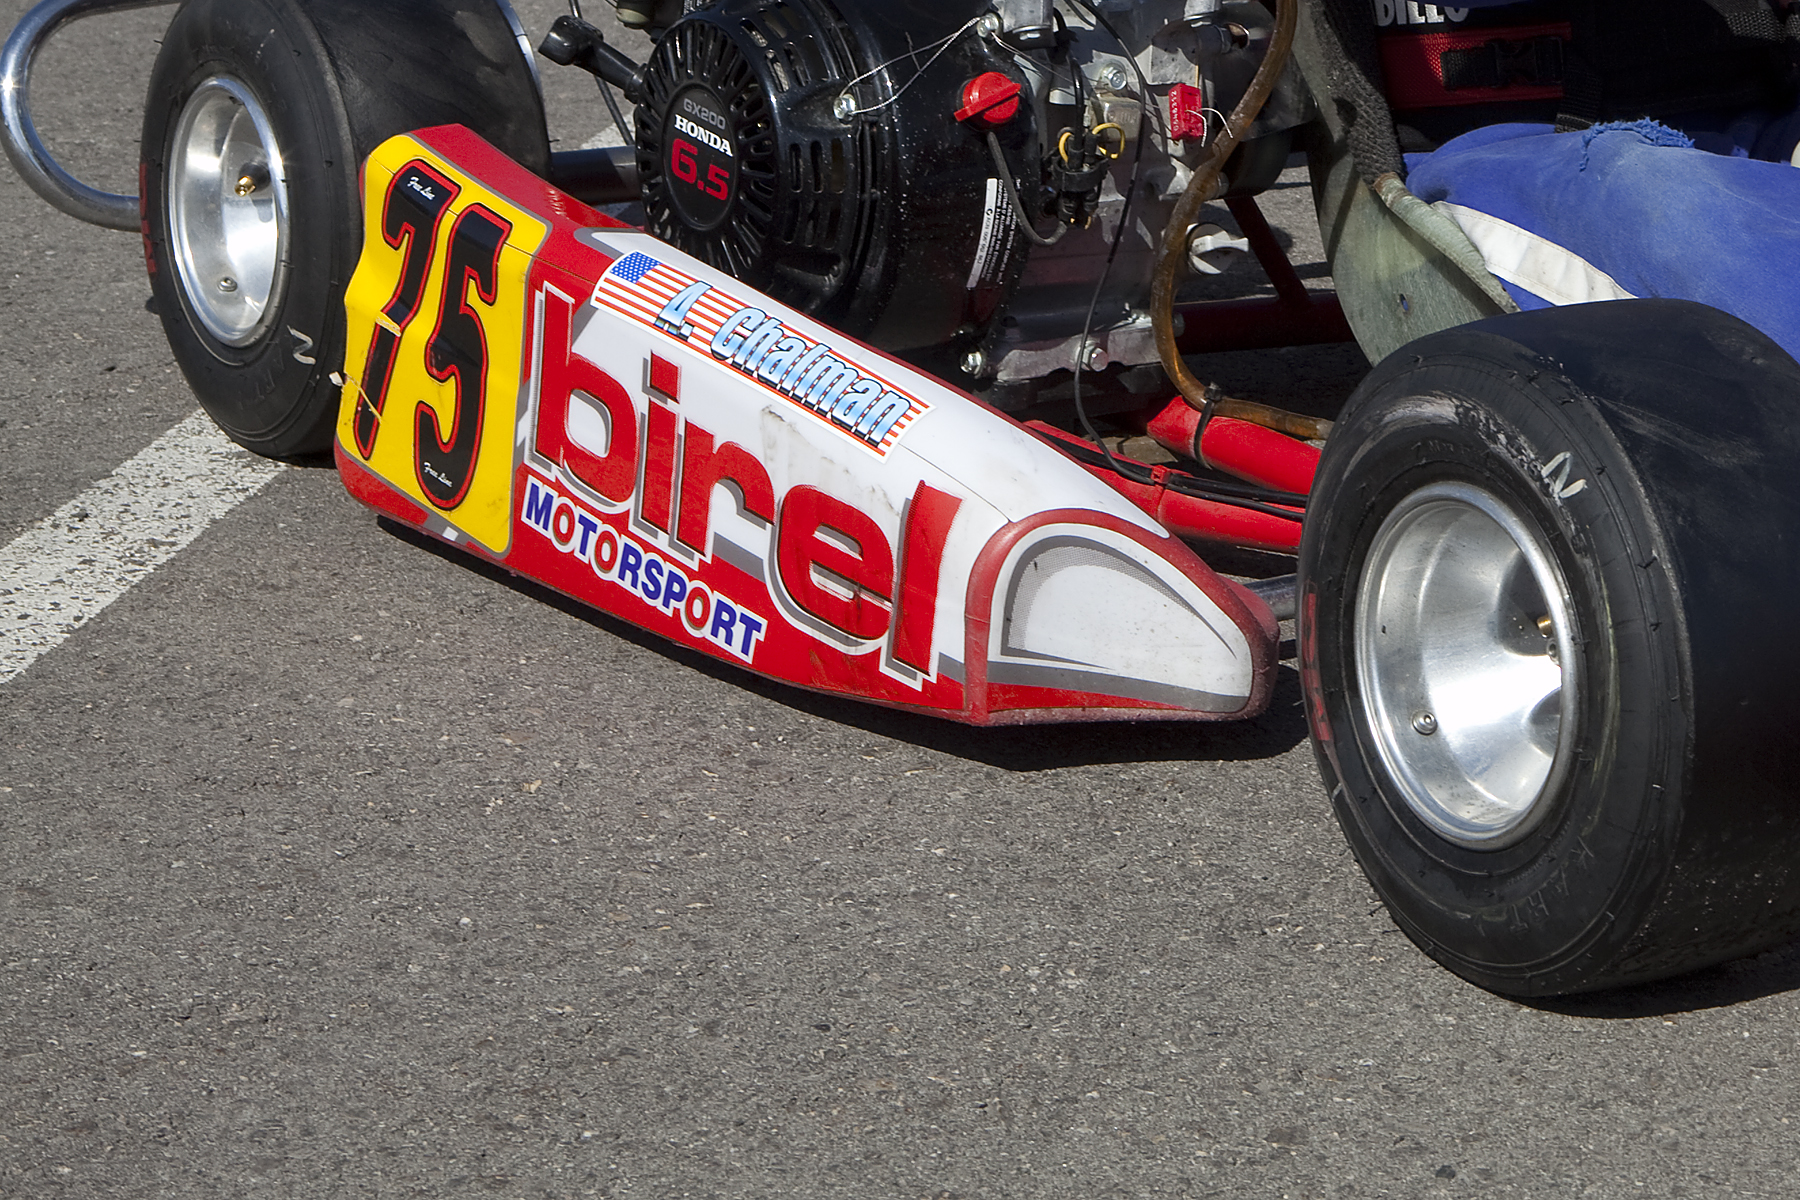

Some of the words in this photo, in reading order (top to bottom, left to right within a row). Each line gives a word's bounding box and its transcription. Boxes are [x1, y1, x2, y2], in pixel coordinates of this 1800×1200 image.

[671, 138, 730, 201] 6.5
[674, 114, 733, 157] HONDA
[683, 98, 726, 130] GX200
[353, 158, 513, 512] 75
[710, 307, 911, 448] Chalman
[534, 284, 963, 677] birel
[524, 481, 764, 658] MOTORSPORT
